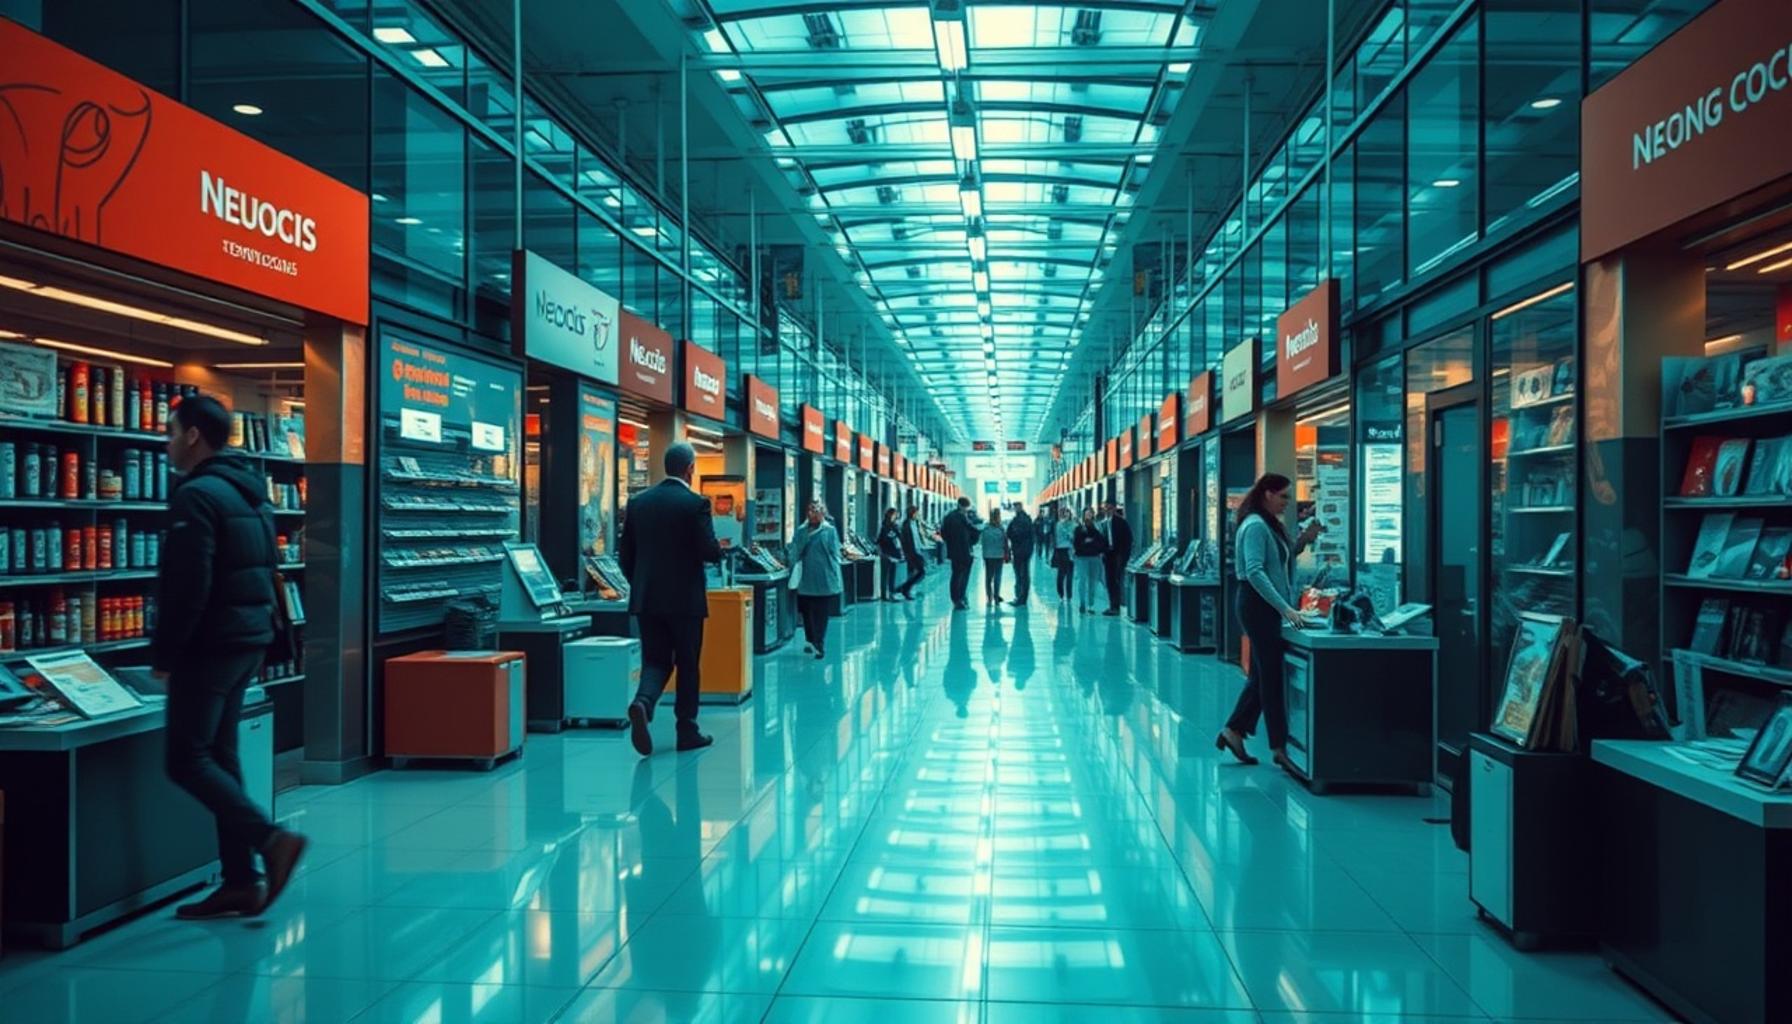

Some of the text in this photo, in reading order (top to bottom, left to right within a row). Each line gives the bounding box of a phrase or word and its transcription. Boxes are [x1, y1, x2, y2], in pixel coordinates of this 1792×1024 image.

[1632, 42, 1792, 170] NEONG COC
[200, 169, 318, 253] NEUOCIS
